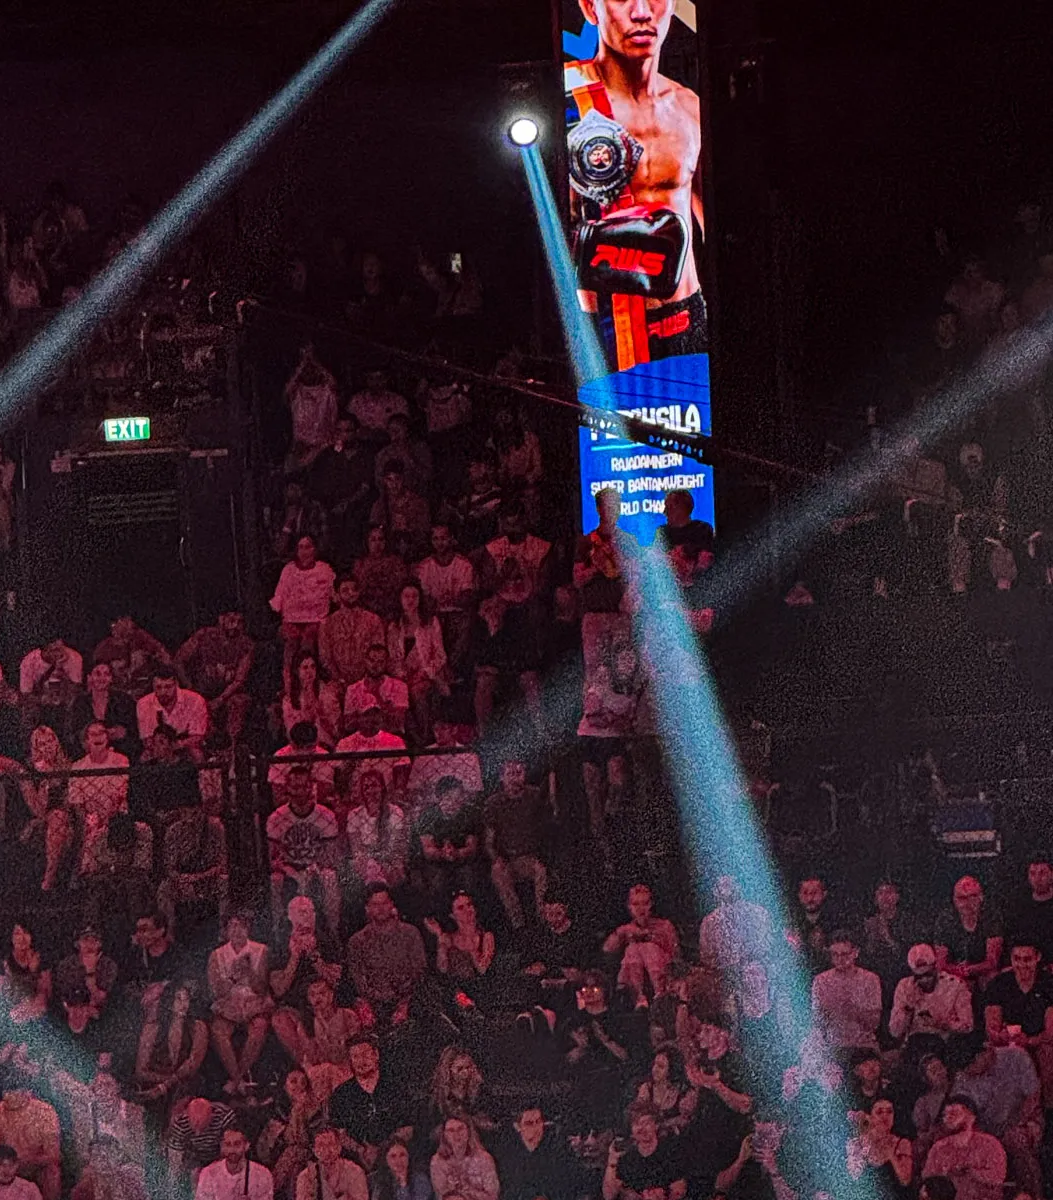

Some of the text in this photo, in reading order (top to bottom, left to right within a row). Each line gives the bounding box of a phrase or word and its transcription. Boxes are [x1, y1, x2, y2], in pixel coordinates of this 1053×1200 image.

[590, 245, 666, 276] RWS
[107, 419, 147, 439] EXIT
[611, 452, 683, 472] RAJADAMNERN
[628, 474, 705, 494] BANTAMWEIGHT
[620, 501, 640, 516] RLD
